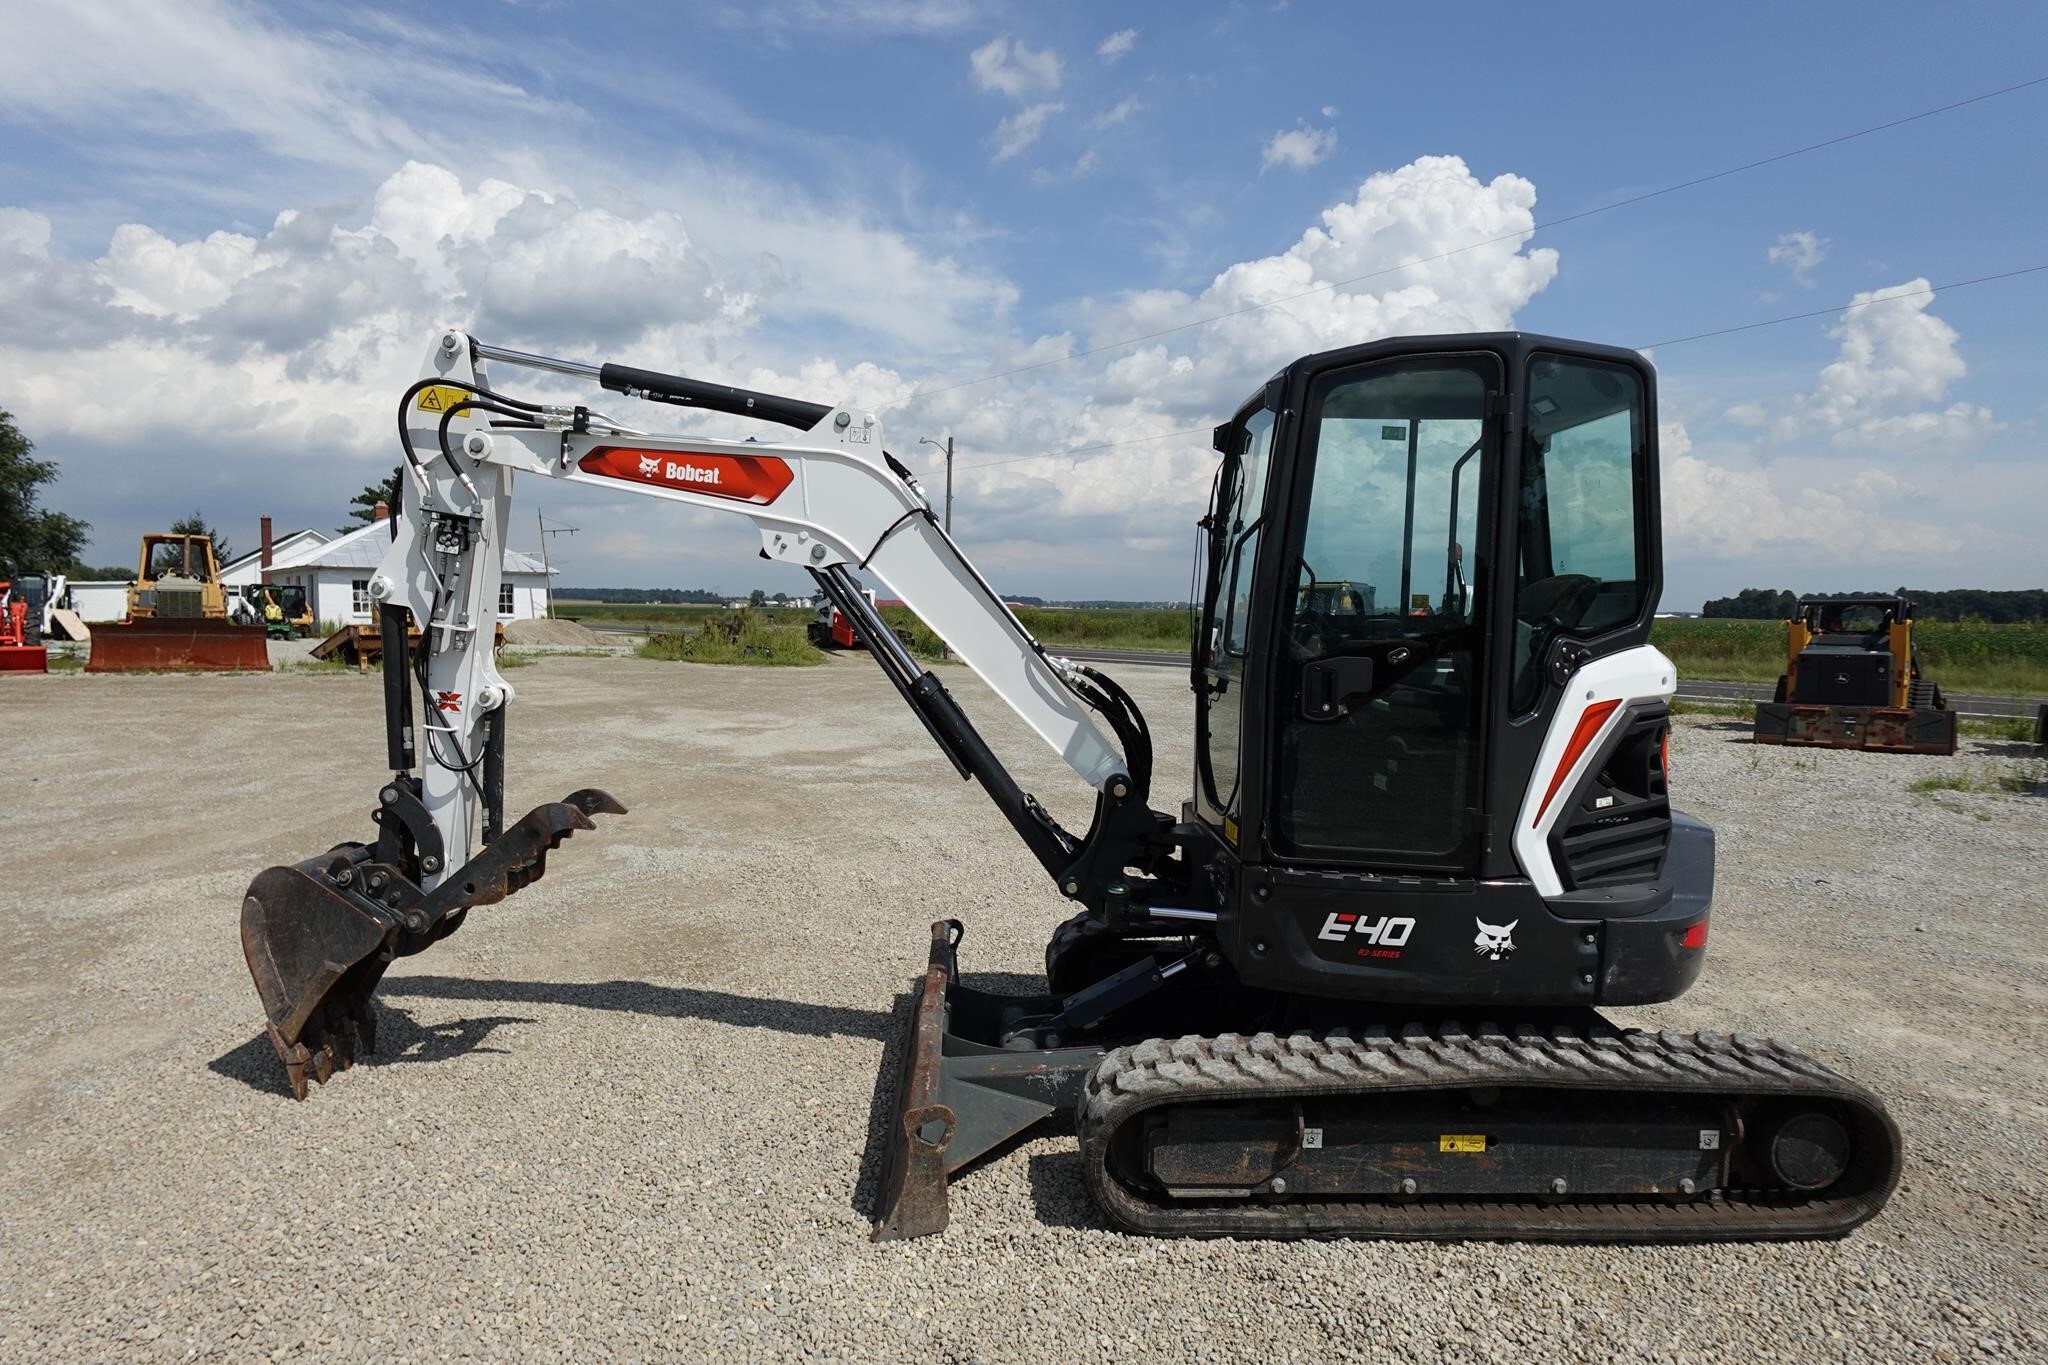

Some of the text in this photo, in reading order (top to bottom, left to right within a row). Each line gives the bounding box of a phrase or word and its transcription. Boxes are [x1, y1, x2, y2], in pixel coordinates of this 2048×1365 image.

[666, 462, 719, 484] Bobcat
[1317, 912, 1416, 946] E40
[1357, 948, 1401, 959] R2-SERIES
